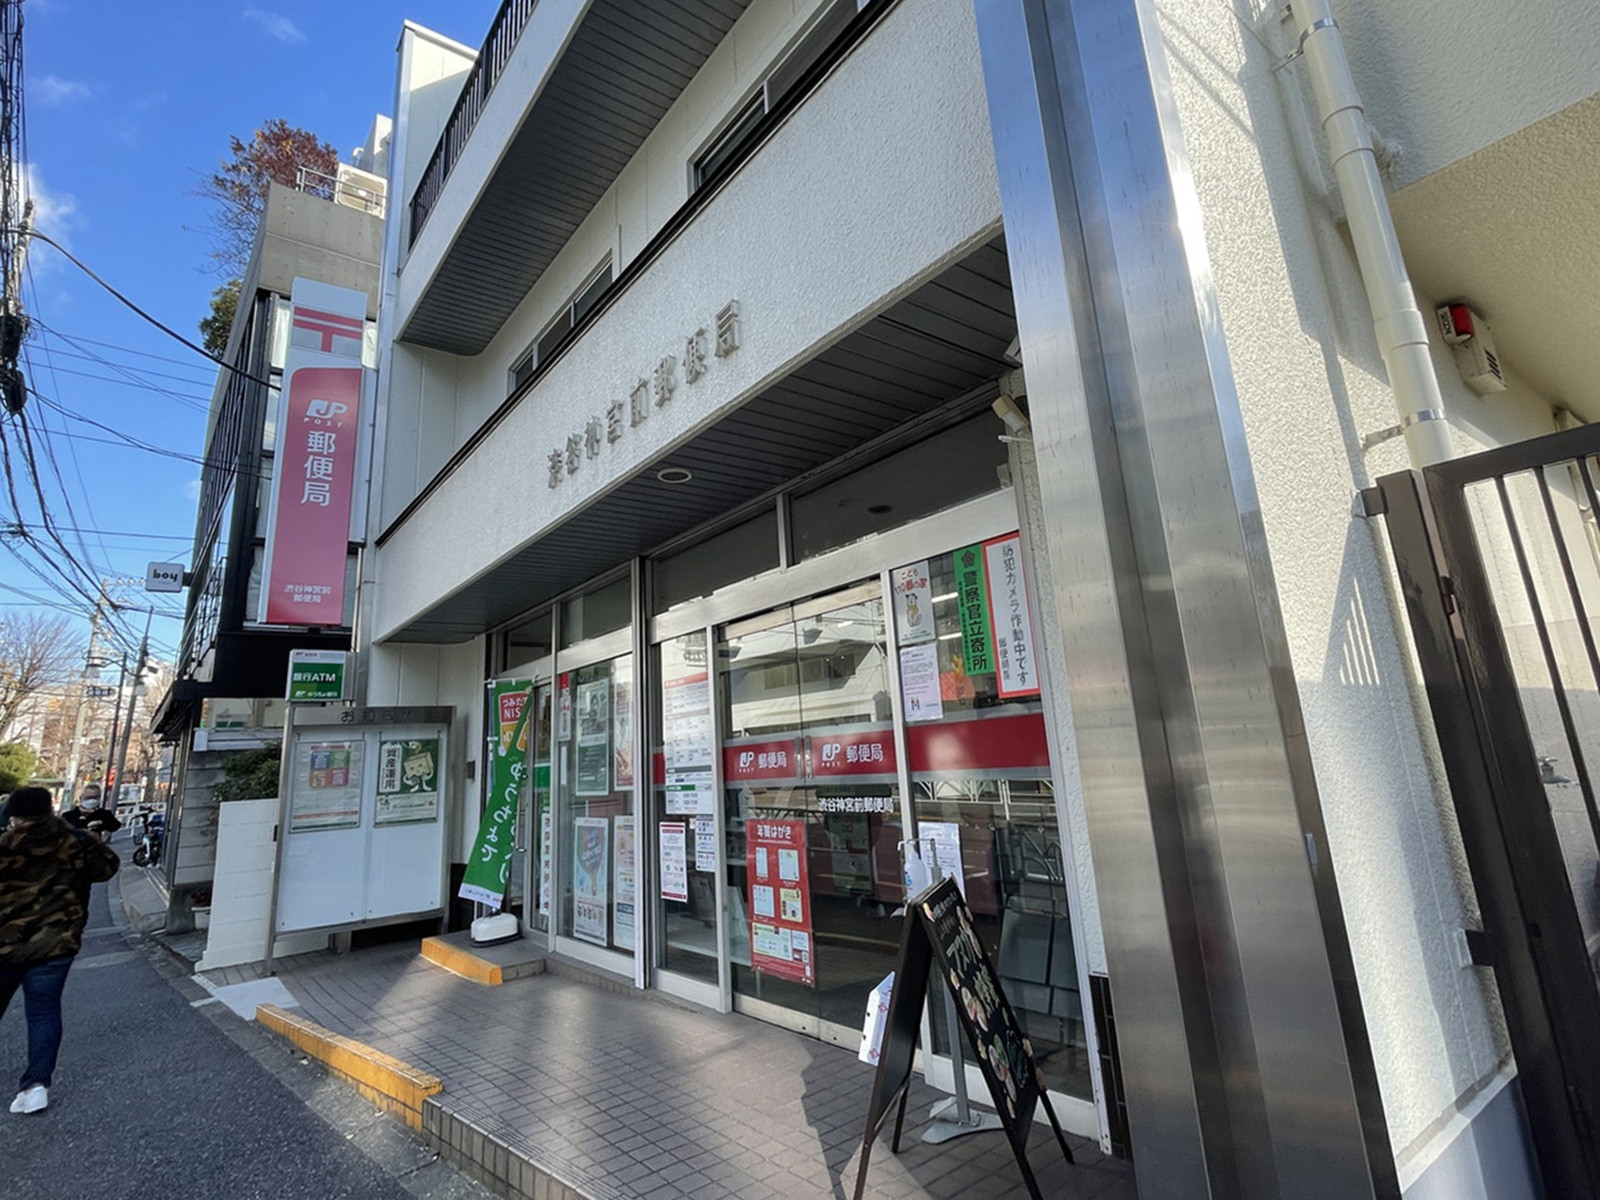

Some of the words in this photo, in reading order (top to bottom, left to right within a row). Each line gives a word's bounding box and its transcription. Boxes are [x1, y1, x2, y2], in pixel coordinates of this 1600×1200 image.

[301, 430, 337, 507] 郵便局
[152, 569, 178, 582] boy
[284, 584, 332, 595] 渋谷神宮前
[293, 594, 321, 603] 郵便局
[963, 570, 988, 671] 警察官立寄所
[1002, 544, 1029, 686] 防犯カメラ作動中です
[504, 708, 521, 718] NIS
[758, 751, 787, 769] 郵便局
[846, 743, 883, 763] 郵便局
[384, 748, 397, 790] 資産運用
[818, 796, 894, 813] 渋谷神宮前郵便局
[757, 824, 792, 839] 年賀はがき
